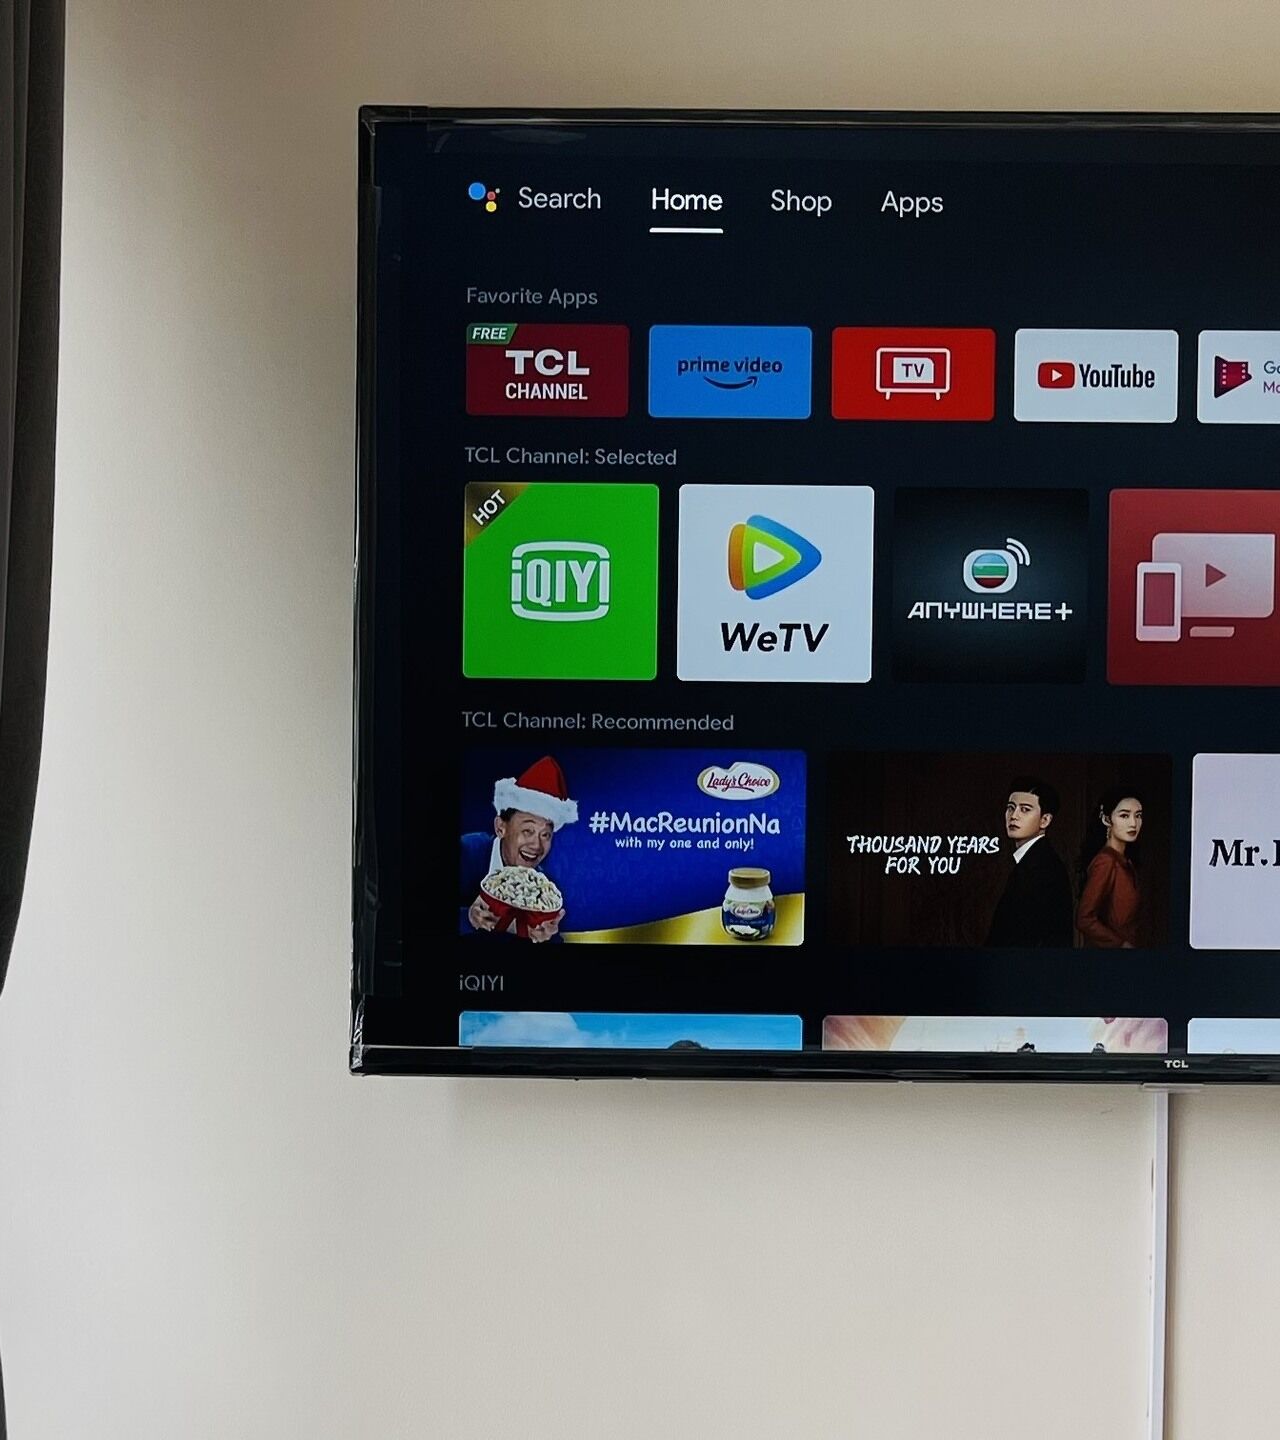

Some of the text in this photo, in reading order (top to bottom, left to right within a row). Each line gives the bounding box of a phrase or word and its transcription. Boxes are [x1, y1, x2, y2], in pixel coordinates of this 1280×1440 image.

[518, 186, 601, 211] Search
[652, 187, 723, 212] Home
[770, 189, 832, 216] Shop
[881, 190, 943, 217] Apps
[466, 287, 598, 309] Favorite Apps
[471, 327, 508, 341] FREE
[505, 349, 590, 375] TCL
[677, 355, 783, 377] prime video
[901, 363, 926, 378] TV
[1079, 364, 1155, 389] YouTube
[505, 382, 588, 400] CHANNEL
[465, 447, 677, 466] TCL Channel: Selected
[472, 490, 507, 527] HOT
[511, 557, 610, 604] iQIYI
[720, 622, 830, 653] WeTV
[461, 712, 734, 731] TCL Channel: Recommended
[737, 771, 771, 791] Choice
[588, 811, 780, 835] #MacReunionNa
[615, 837, 754, 852] with my one and only!
[846, 835, 1000, 854] THOUSAND YEARS
[885, 856, 961, 875] FOR YOU
[459, 974, 504, 992] iQIYI
[1164, 1059, 1189, 1069] TCL
